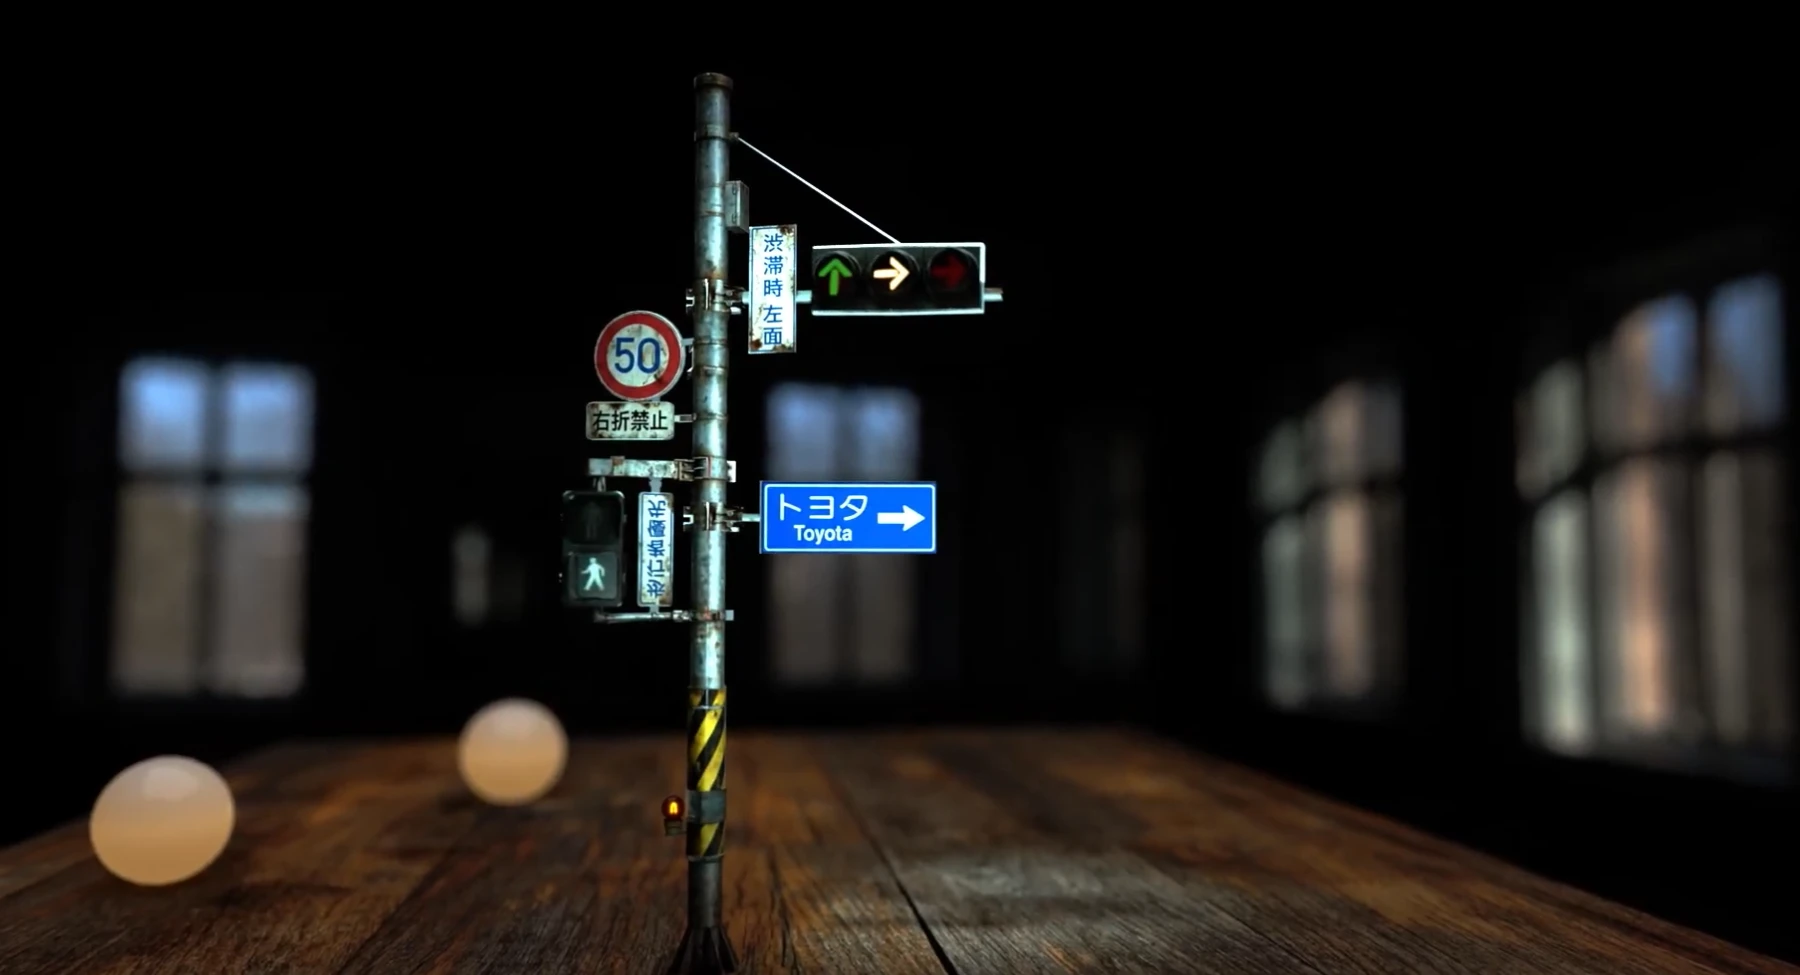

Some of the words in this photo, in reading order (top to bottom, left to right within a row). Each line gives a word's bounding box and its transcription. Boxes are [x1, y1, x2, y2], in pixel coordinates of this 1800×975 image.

[614, 337, 661, 374] 50
[592, 410, 669, 432] 右折禁止
[779, 493, 869, 522] トヨタ
[793, 524, 853, 545] Toyota
